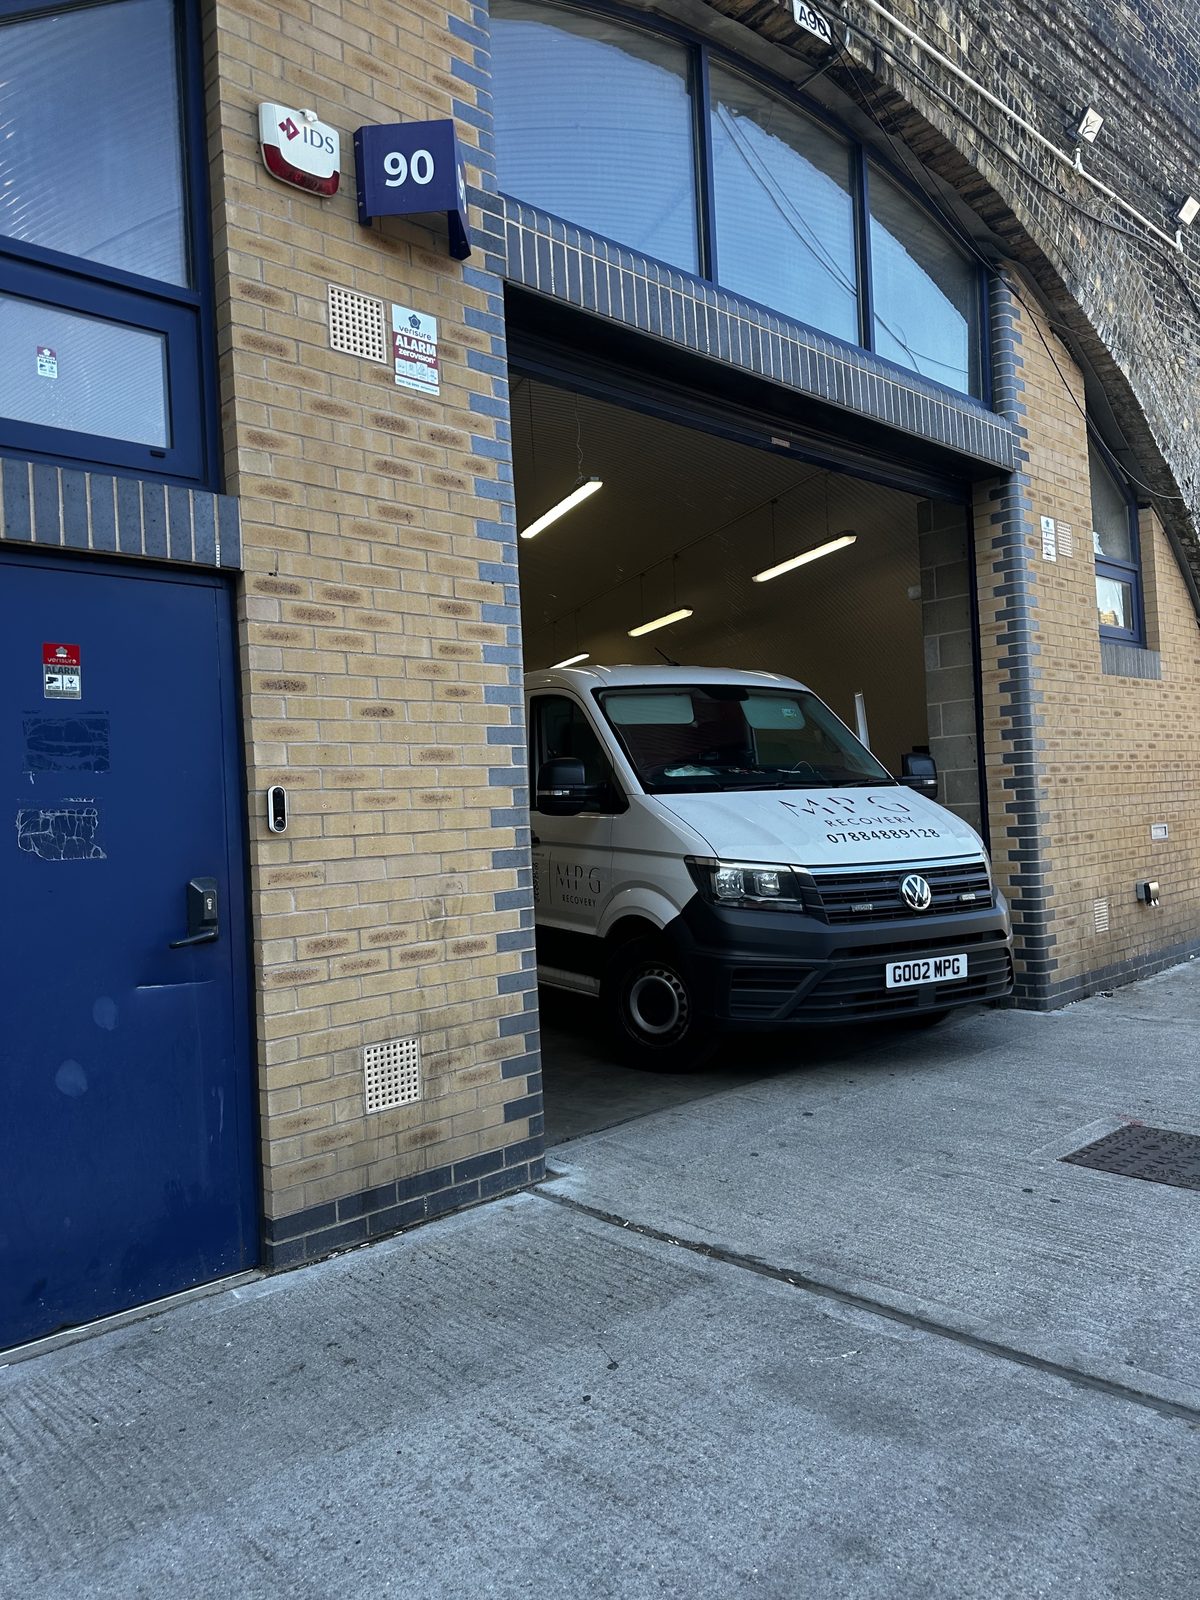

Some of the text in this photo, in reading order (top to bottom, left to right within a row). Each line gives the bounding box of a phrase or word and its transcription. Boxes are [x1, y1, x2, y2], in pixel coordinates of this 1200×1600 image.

[303, 126, 335, 154] IDS
[383, 149, 435, 188] 90
[398, 325, 432, 341] verisure
[395, 334, 437, 357] ALARM
[46, 665, 79, 676] ALARM
[778, 795, 911, 817] MPG
[824, 816, 915, 828] RECOVERY
[826, 828, 940, 844] 07884889128
[556, 864, 601, 894] MPG
[562, 894, 597, 907] RECOVERY
[934, 958, 960, 978] MPG
